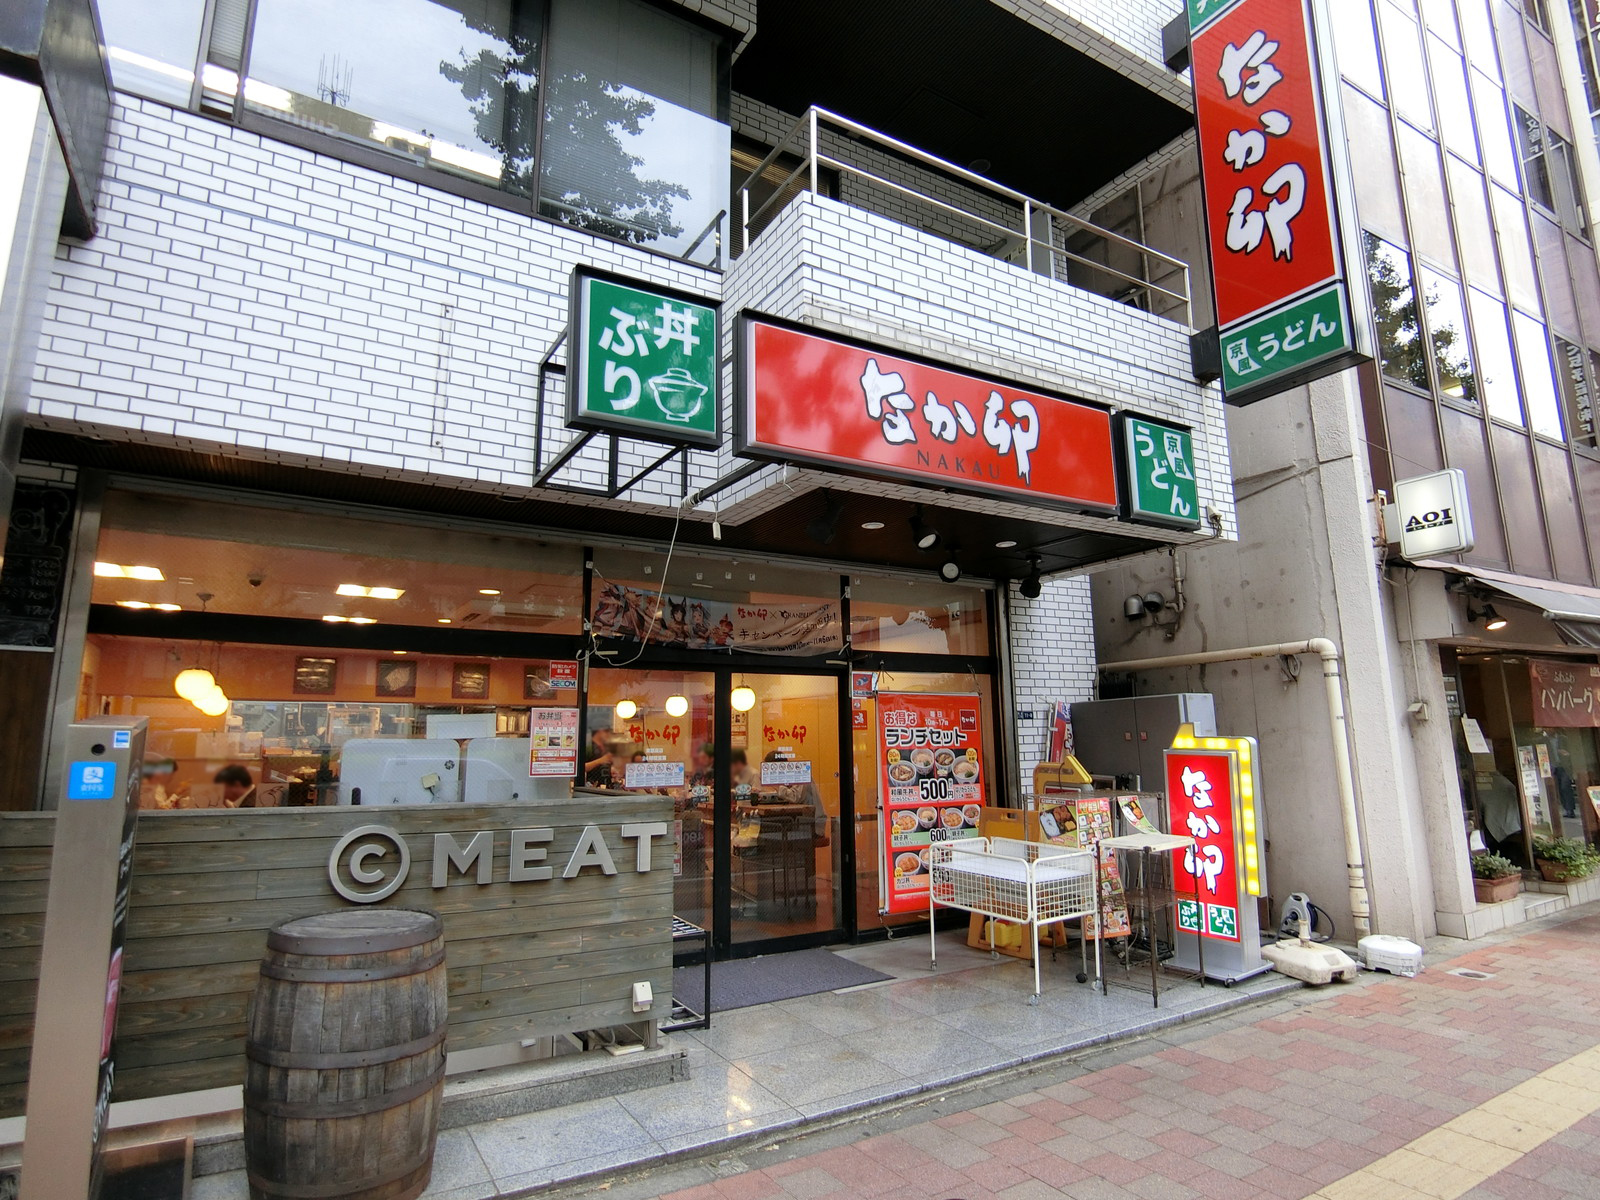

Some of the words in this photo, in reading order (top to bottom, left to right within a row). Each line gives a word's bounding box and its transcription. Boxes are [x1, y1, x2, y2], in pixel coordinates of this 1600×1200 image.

[1218, 29, 1307, 263] なか卯
[1257, 313, 1337, 361] うどん
[860, 358, 1041, 487] なか卯
[917, 450, 1000, 479] NAKAU
[1405, 508, 1452, 528] AOI
[737, 607, 768, 621] なか卯
[551, 680, 576, 688] SECOM
[1541, 687, 1594, 713] ハンバーグ
[538, 712, 562, 720] お弁当
[884, 710, 917, 725] お得な
[629, 724, 681, 745] なか卯
[763, 724, 807, 744] なか卯
[885, 727, 967, 746] ランチセット
[1181, 766, 1224, 895] なか卯
[432, 822, 668, 888] MEAT
